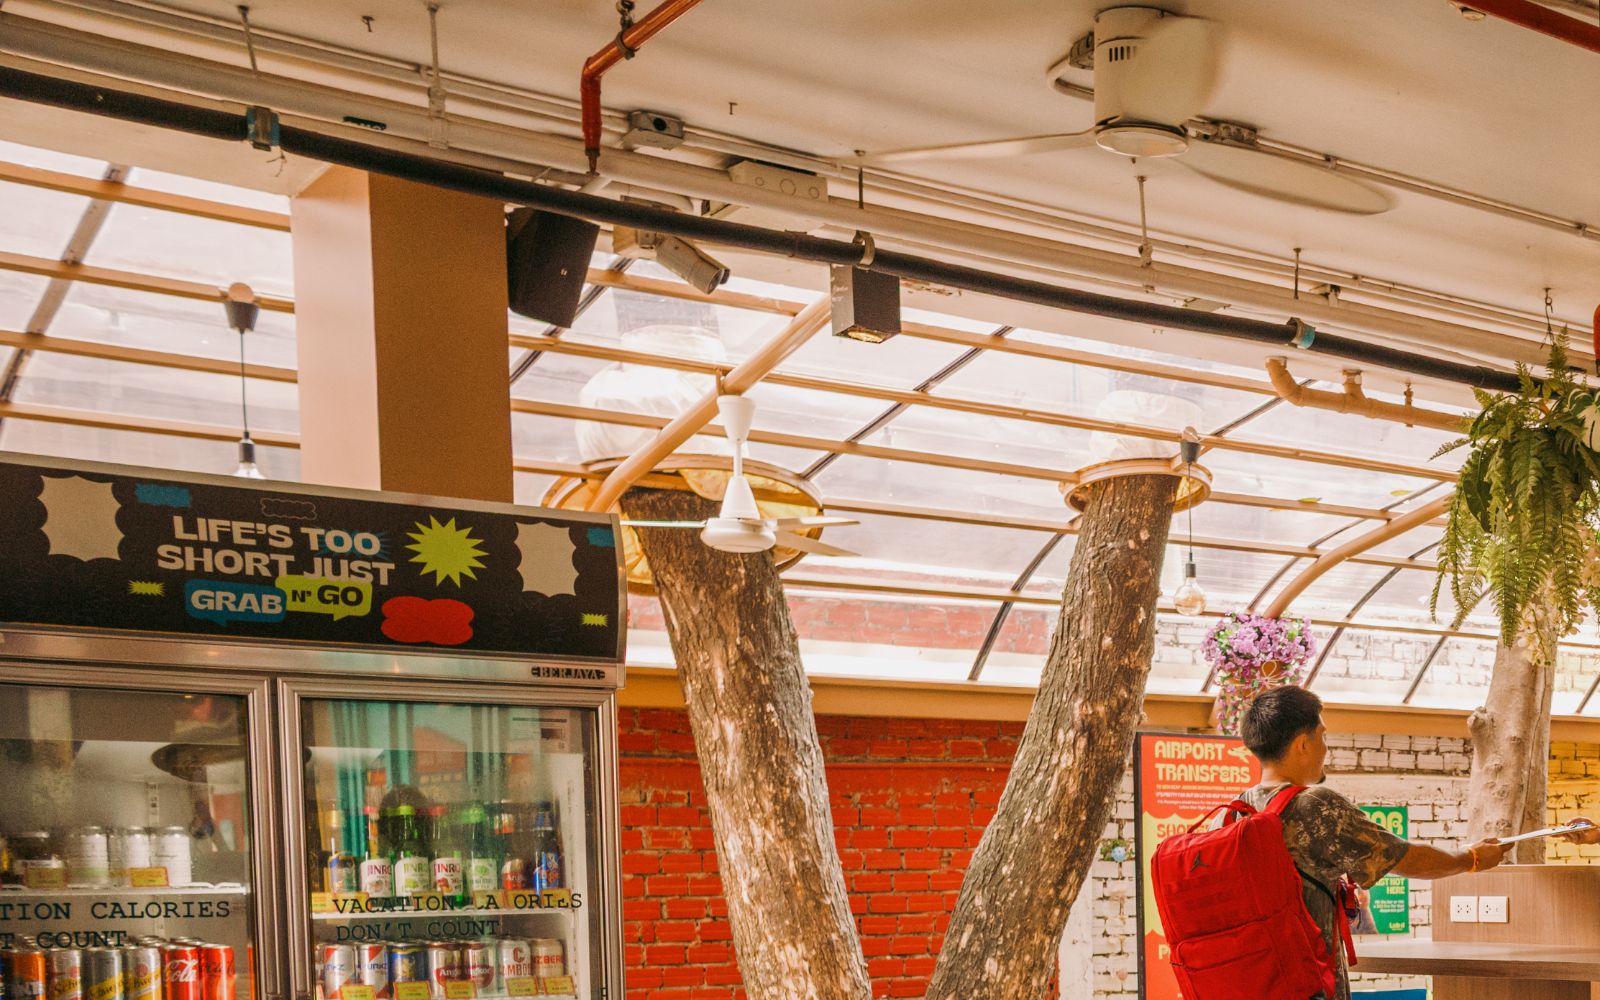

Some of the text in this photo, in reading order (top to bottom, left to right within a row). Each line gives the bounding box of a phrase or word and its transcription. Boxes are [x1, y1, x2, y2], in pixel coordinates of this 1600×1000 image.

[173, 515, 381, 556] LIFE'S TOO
[157, 544, 396, 586] SHORT JUST
[190, 589, 283, 615] GRAB
[317, 584, 364, 607] GO
[1154, 740, 1225, 761] AIRPORT
[1154, 762, 1251, 783] TRANSFERS
[91, 900, 230, 919] CALORIES
[332, 895, 455, 914] VACATION
[336, 922, 412, 941] DON'T
